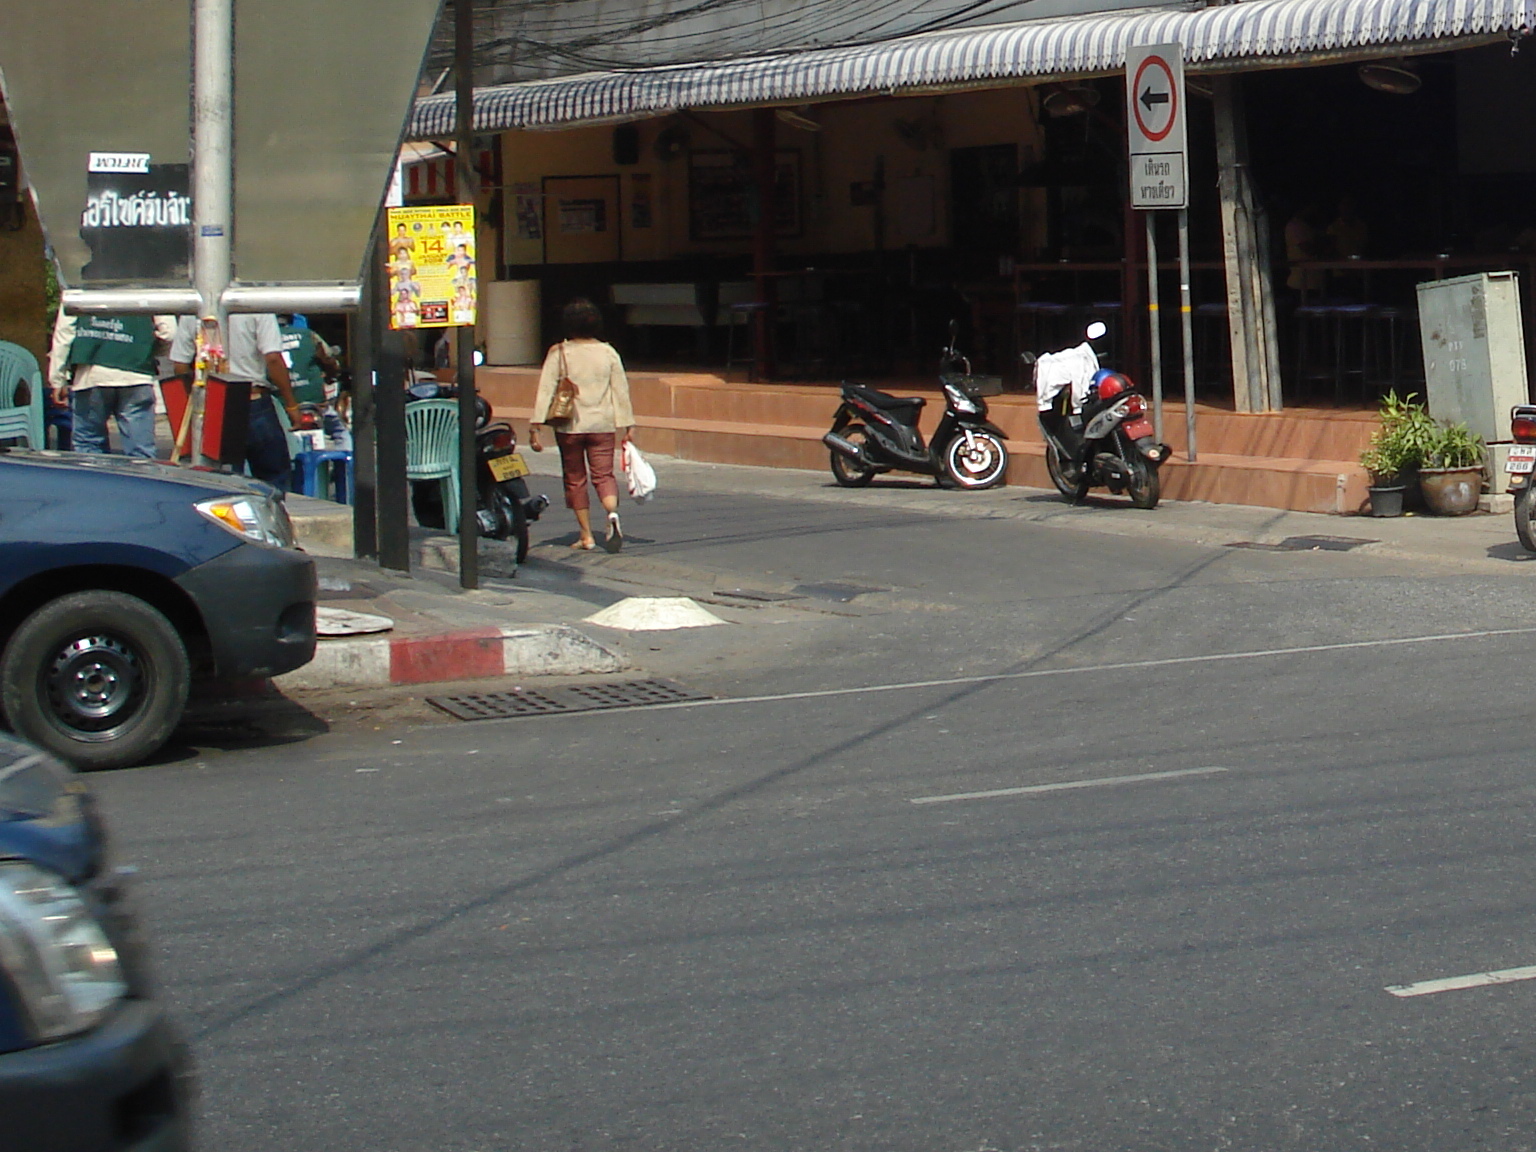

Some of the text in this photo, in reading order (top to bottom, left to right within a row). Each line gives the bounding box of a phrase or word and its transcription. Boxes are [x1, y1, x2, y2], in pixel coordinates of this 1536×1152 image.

[1144, 157, 1170, 177] เดินรถ
[1140, 180, 1175, 199] ทางเดียว
[82, 188, 191, 227] อร์ไซค์รับจ้า
[439, 210, 472, 219] BATTLE
[420, 239, 445, 254] 14
